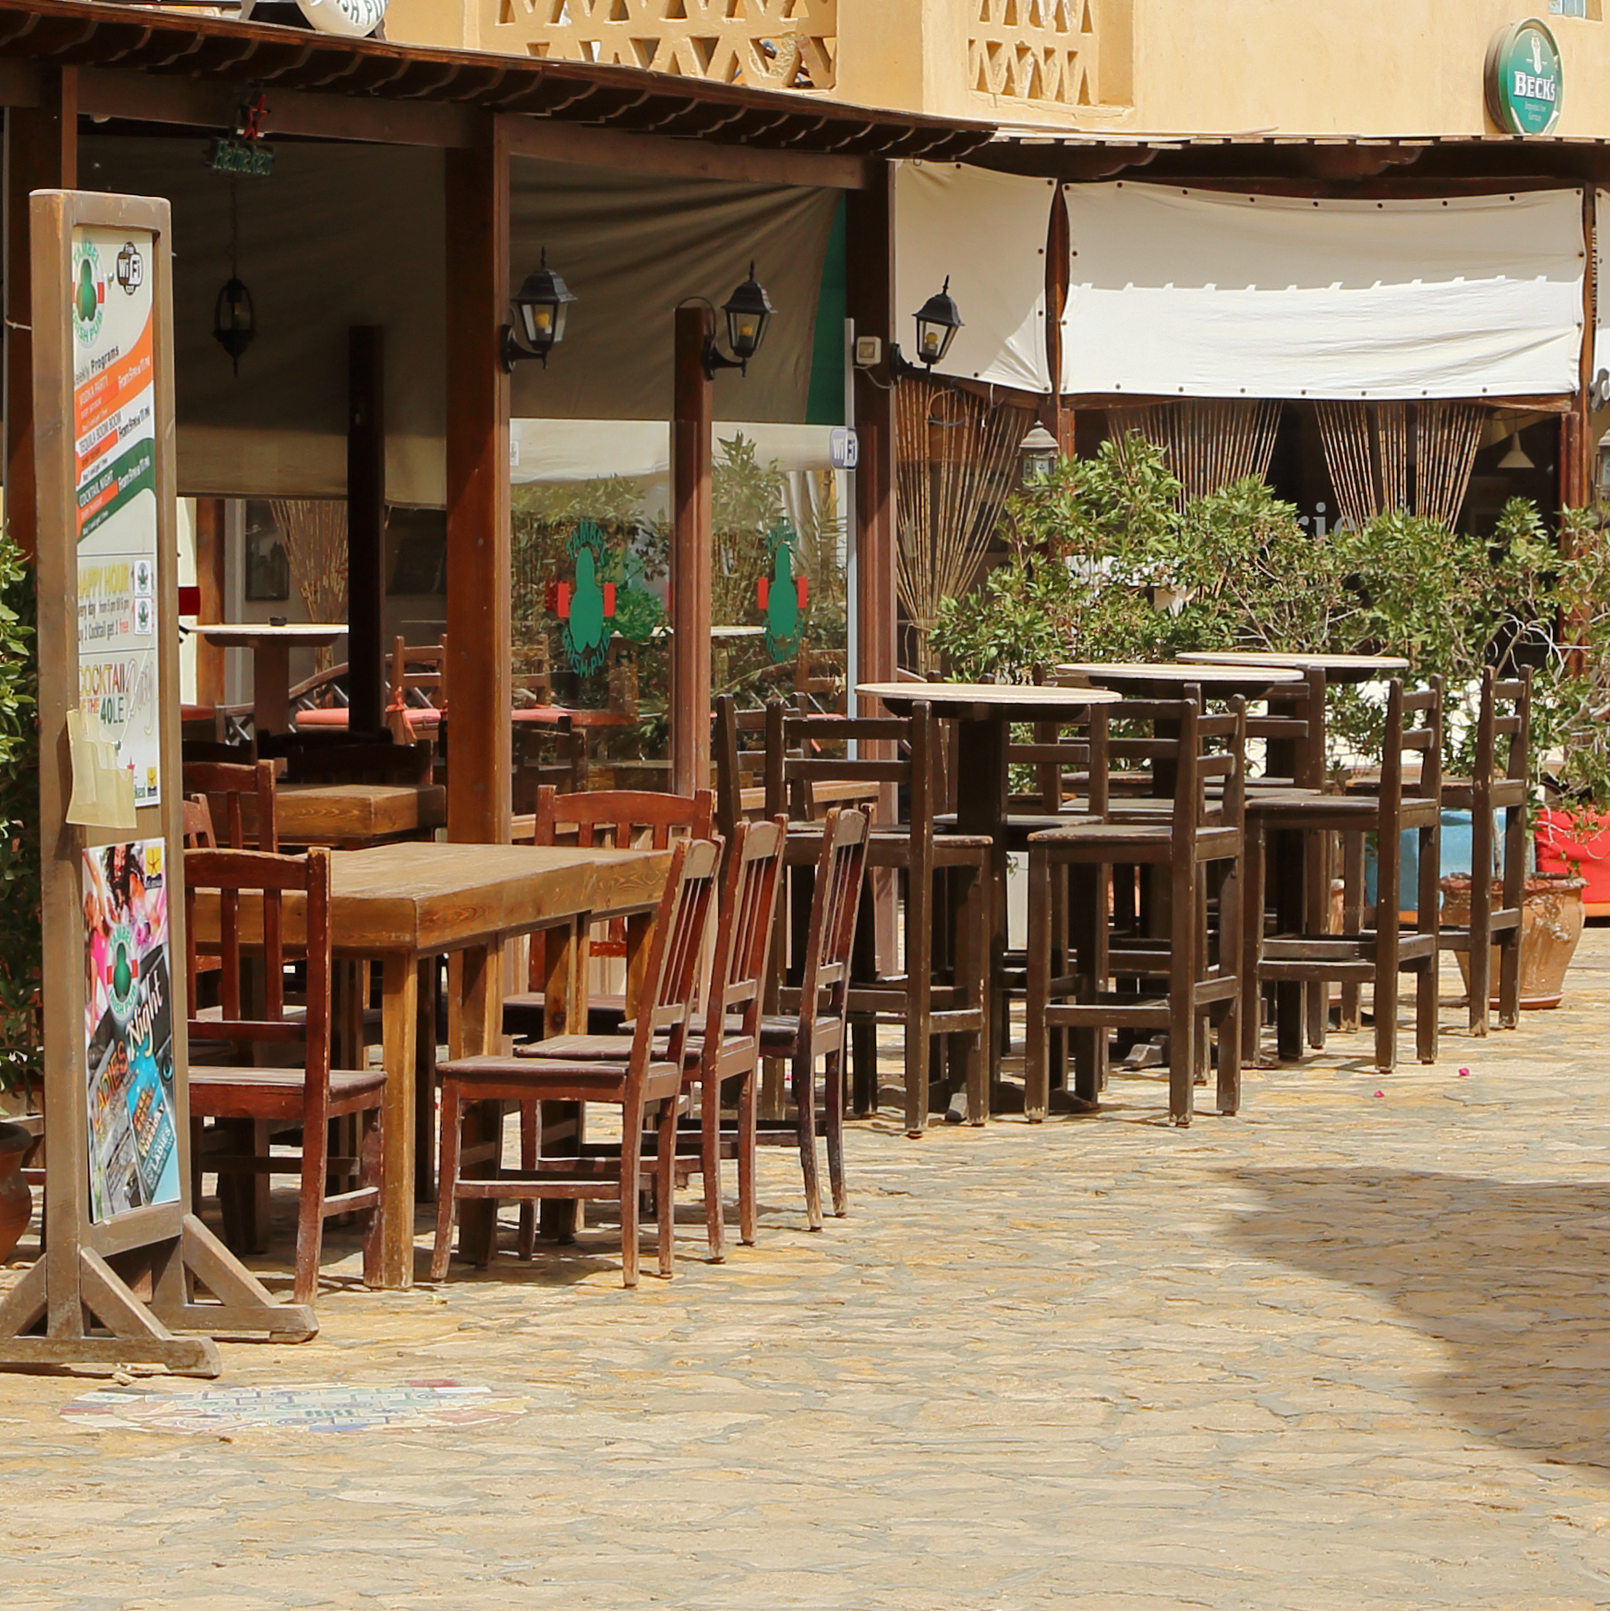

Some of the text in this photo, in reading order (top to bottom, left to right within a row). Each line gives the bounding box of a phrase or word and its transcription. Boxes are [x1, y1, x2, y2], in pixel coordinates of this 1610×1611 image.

[91, 345, 119, 374] Programs
[89, 620, 106, 640] Cocktail
[109, 925, 133, 953] TAMBEL
[125, 969, 163, 1062] Night
[94, 1039, 129, 1134] LADIES
